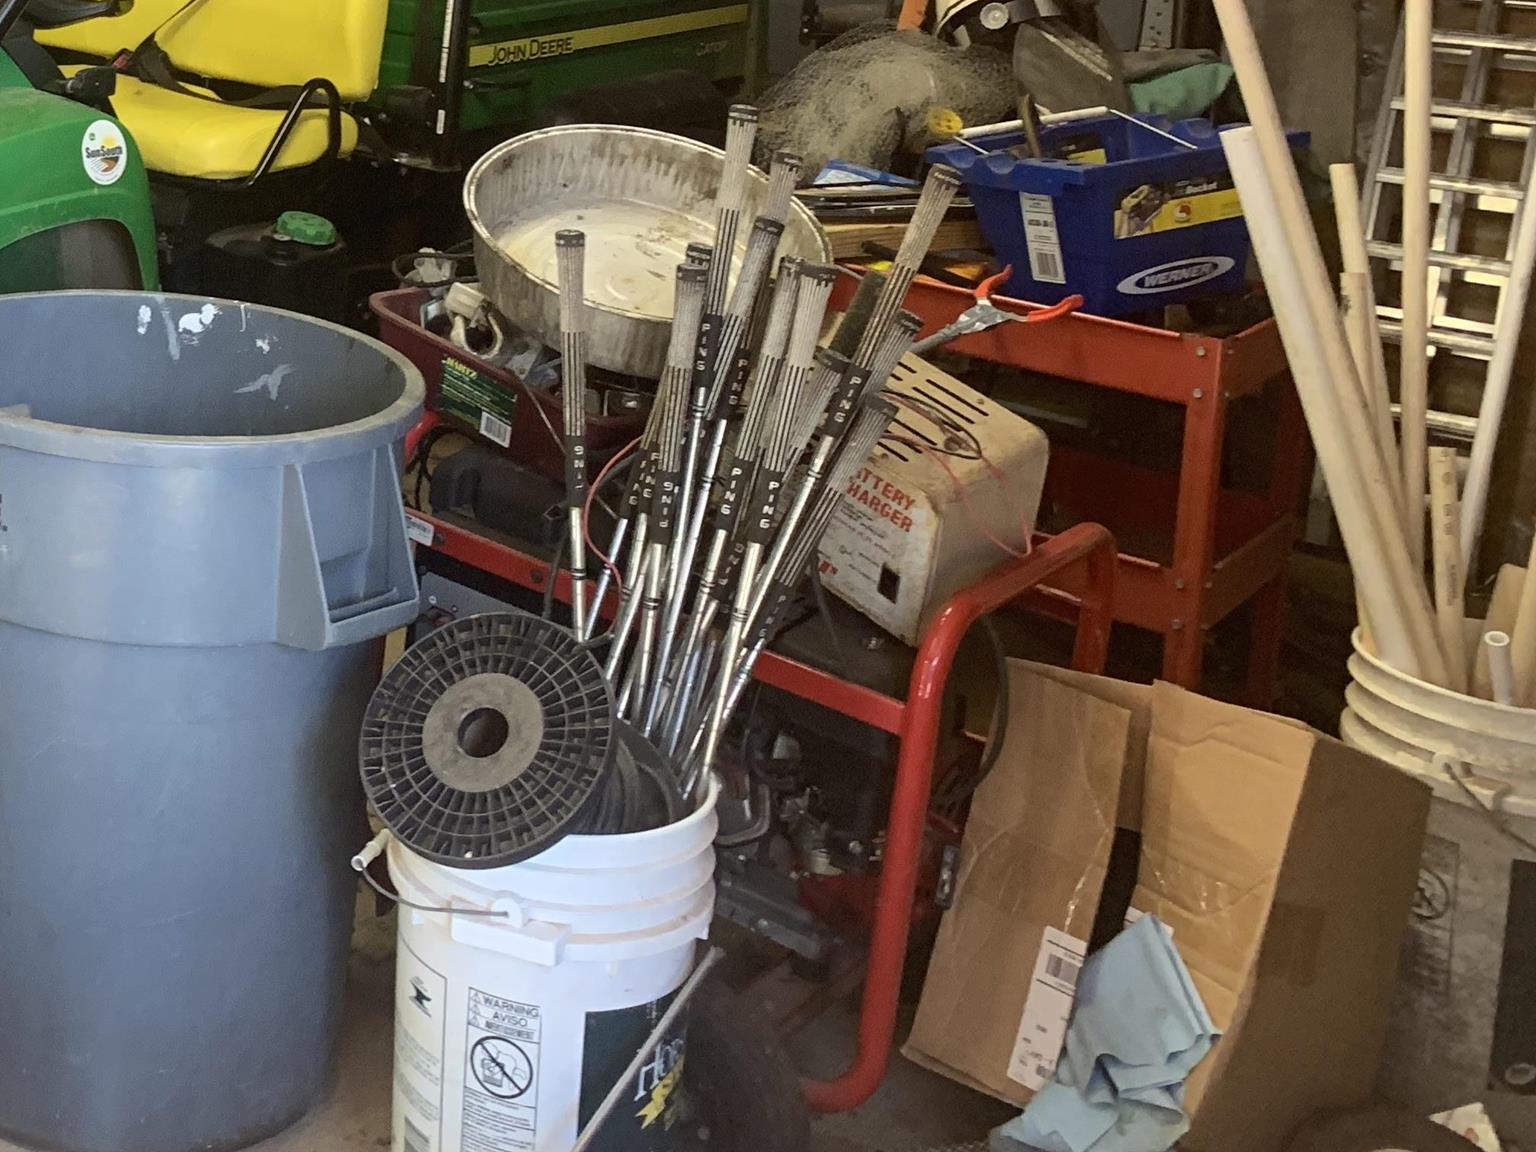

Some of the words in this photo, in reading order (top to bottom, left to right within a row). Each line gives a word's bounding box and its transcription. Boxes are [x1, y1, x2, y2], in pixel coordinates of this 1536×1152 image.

[488, 44, 527, 66] JOHN
[529, 37, 574, 59] DEERE
[1143, 262, 1212, 288] WERNER
[697, 323, 711, 371] PING
[728, 358, 748, 405] PING
[833, 377, 862, 422] PING
[659, 481, 674, 528] PING
[720, 467, 742, 516] PING
[759, 481, 779, 529] PING
[847, 480, 913, 532] HARGER
[853, 468, 916, 510] TTERY
[483, 996, 539, 1017] WARNING
[492, 1012, 527, 1026] AVISO
